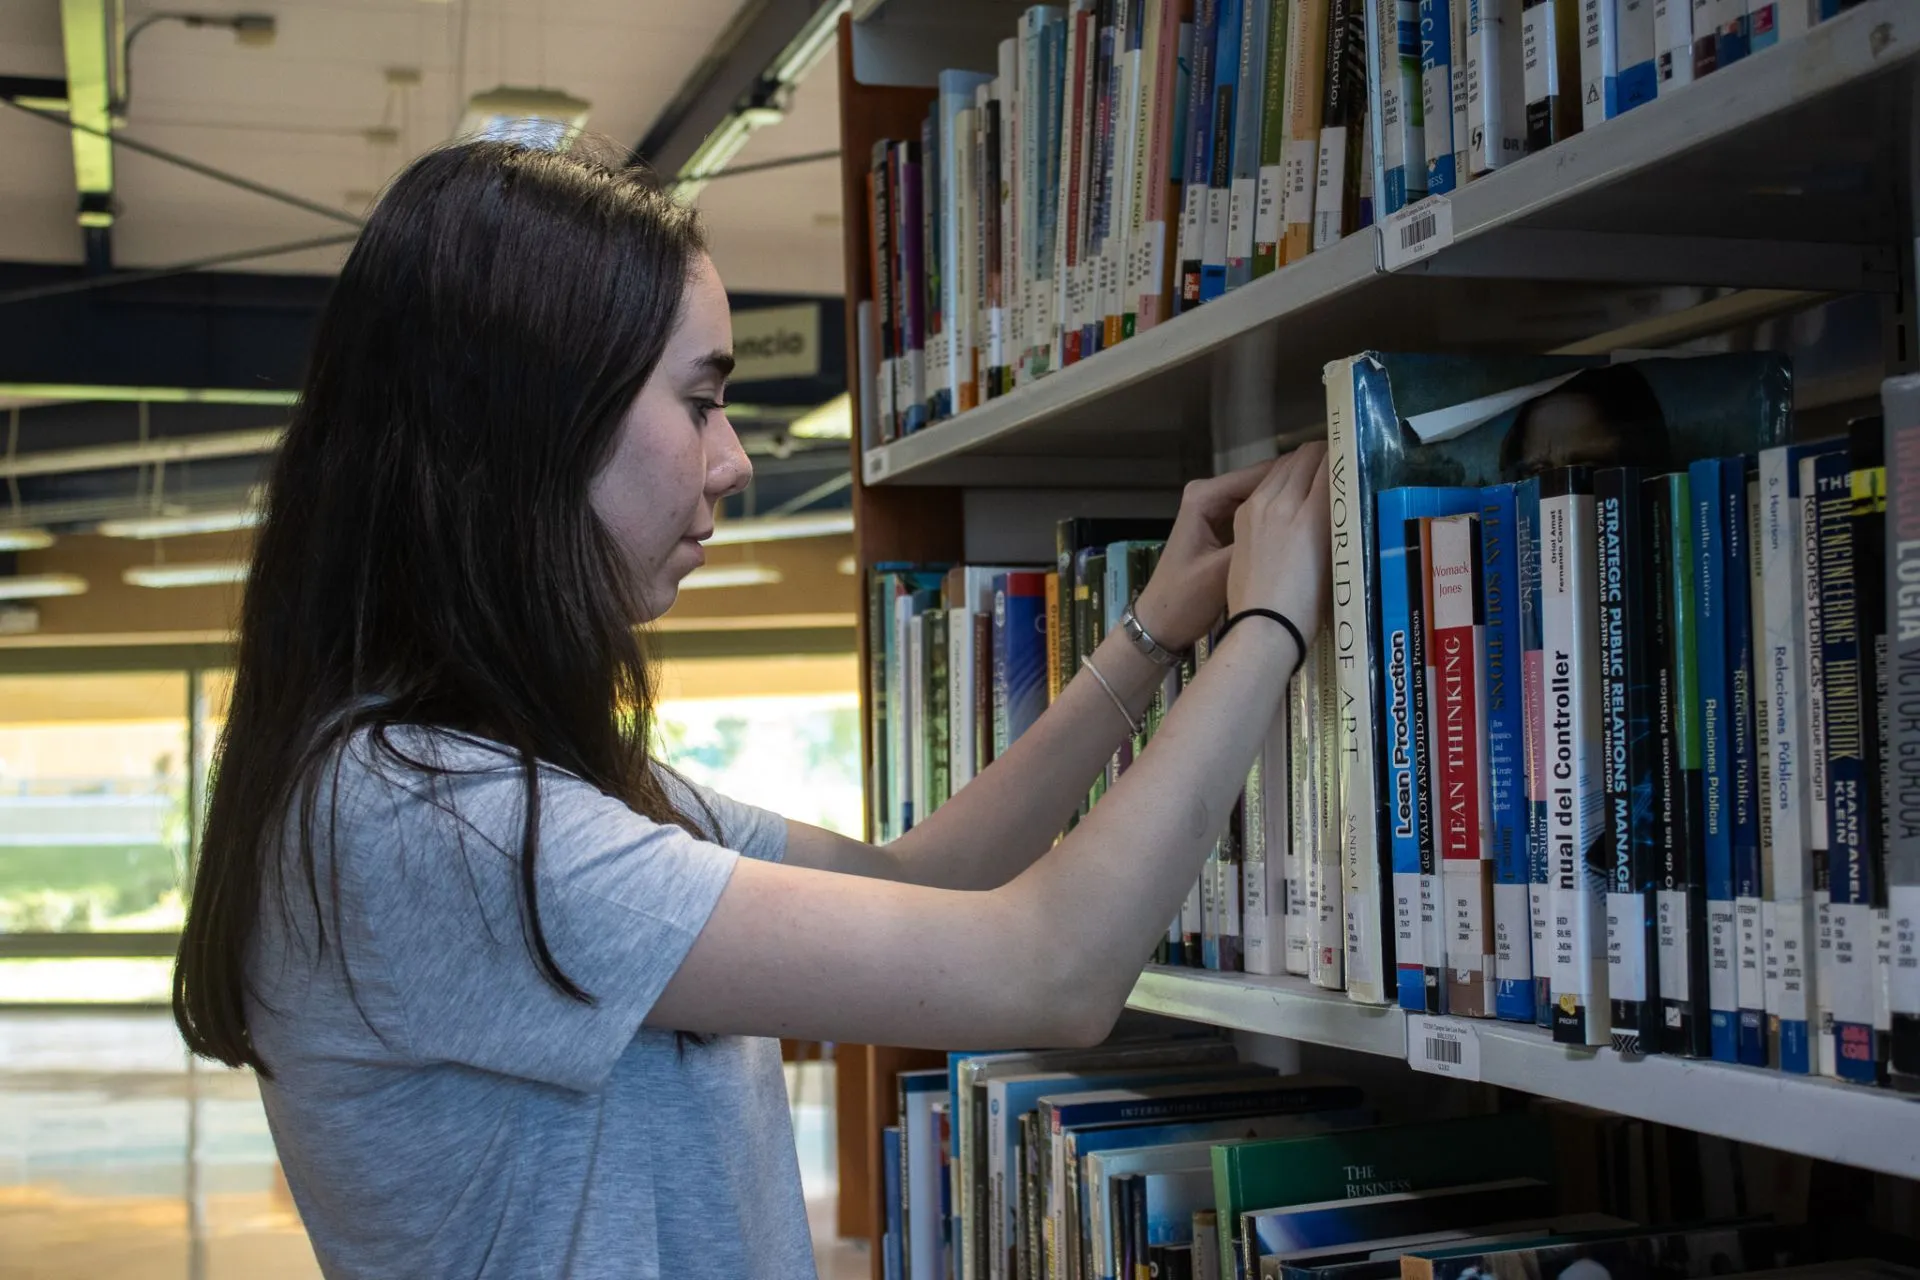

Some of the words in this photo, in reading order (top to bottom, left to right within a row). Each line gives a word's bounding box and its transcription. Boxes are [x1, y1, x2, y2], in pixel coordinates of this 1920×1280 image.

[1331, 27, 1344, 109] Behavior
[734, 327, 804, 357] ncio
[1332, 407, 1341, 448] THE
[1769, 477, 1779, 490] S.
[1818, 474, 1852, 492] THE
[1331, 453, 1353, 607] WORLD
[1597, 502, 1605, 533] ERICA
[1699, 500, 1711, 549] Bonilla
[1769, 494, 1782, 550] Harrison
[1432, 563, 1470, 576] Womack
[1519, 516, 1532, 613] THINKING
[1598, 537, 1607, 603] WEINTRAUB
[1604, 497, 1621, 602] STRATEGIC
[1804, 495, 1820, 601] Relaciones
[1819, 496, 1858, 645] REENGINEERING
[1438, 582, 1463, 597] Jones
[1339, 620, 1355, 669] OF
[1411, 609, 1422, 666] Procesos
[1486, 573, 1506, 713] SOLUTIONS
[1600, 605, 1609, 648] AUSTIN
[1608, 607, 1624, 677] PUBLIC
[1413, 669, 1423, 689] los
[1601, 649, 1610, 676] AND
[1774, 645, 1789, 735] Relaciones
[1342, 685, 1360, 763] ART
[1391, 631, 1410, 766] Production
[1416, 692, 1424, 708] en
[1443, 636, 1465, 774] THINKING
[1551, 650, 1572, 780] Controller
[1602, 678, 1611, 714] BRUCE
[1658, 668, 1670, 734] Públicas
[1732, 669, 1747, 755] Relaciones
[1757, 700, 1770, 746] PODER
[1811, 698, 1821, 744] ataque
[1825, 658, 1861, 761] HANDBOOK
[1604, 731, 1613, 794] PINKLETON
[1611, 682, 1628, 793] RELATIONS
[1704, 698, 1719, 774] Relaciones
[1760, 751, 1770, 760] E
[1395, 773, 1412, 835] Lean
[1660, 737, 1672, 821] Relaciones
[1736, 758, 1752, 826] Públicas
[1778, 741, 1793, 811] Públicas
[1811, 749, 1826, 803] integral
[1418, 790, 1430, 846] VALOR
[1448, 779, 1468, 851] LEAN
[1553, 788, 1573, 827] del
[1707, 775, 1721, 835] Públicas
[1760, 765, 1773, 849] INFLUENCIA
[1834, 780, 1847, 844] KLEIN
[1421, 849, 1431, 869] del
[1538, 815, 1548, 863] James
[1613, 797, 1631, 893] MANAGE
[1662, 826, 1672, 849] las
[1663, 853, 1673, 872] de
[1556, 916, 1569, 926] HD
[1558, 1017, 1579, 1026] PROFIT
[1342, 1165, 1376, 1181] THE
[1345, 1181, 1413, 1199] BUSINESS
